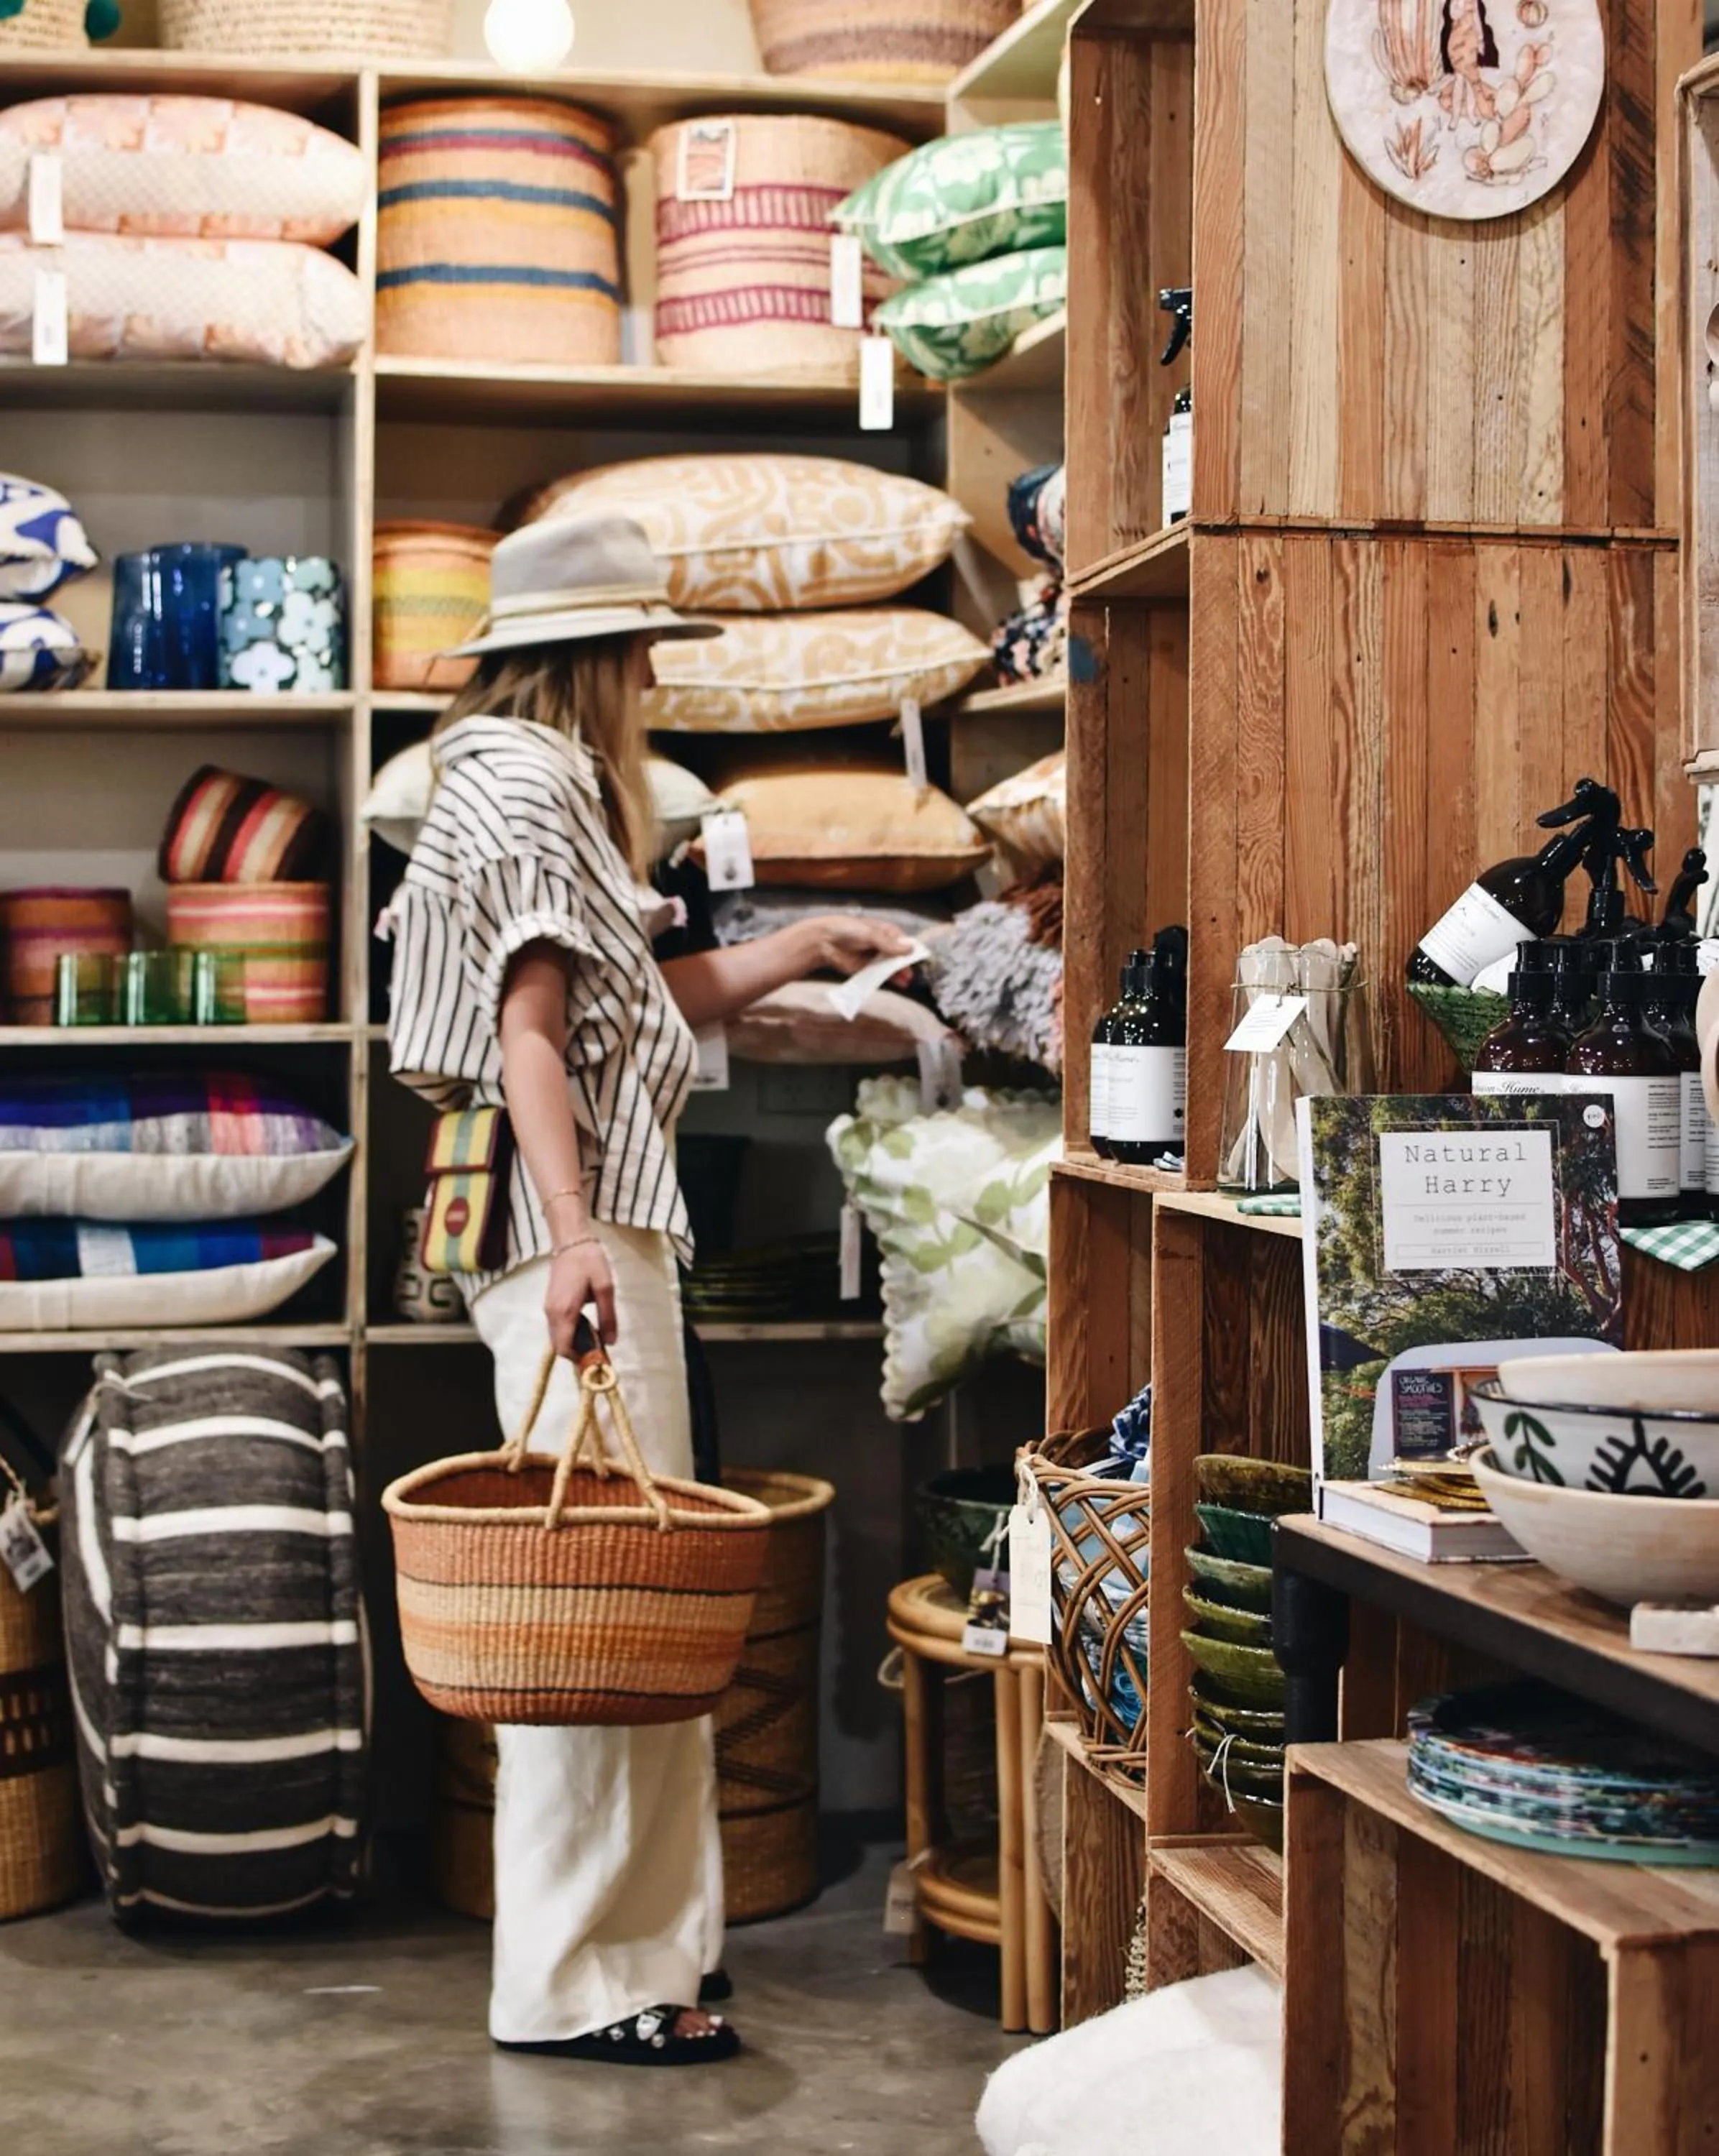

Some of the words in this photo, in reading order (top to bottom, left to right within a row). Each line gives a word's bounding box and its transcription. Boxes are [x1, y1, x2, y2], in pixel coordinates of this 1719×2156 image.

[1404, 1143, 1527, 1163] Natural
[1424, 1175, 1512, 1197] Harry
[1414, 1213, 1462, 1222] Delicious
